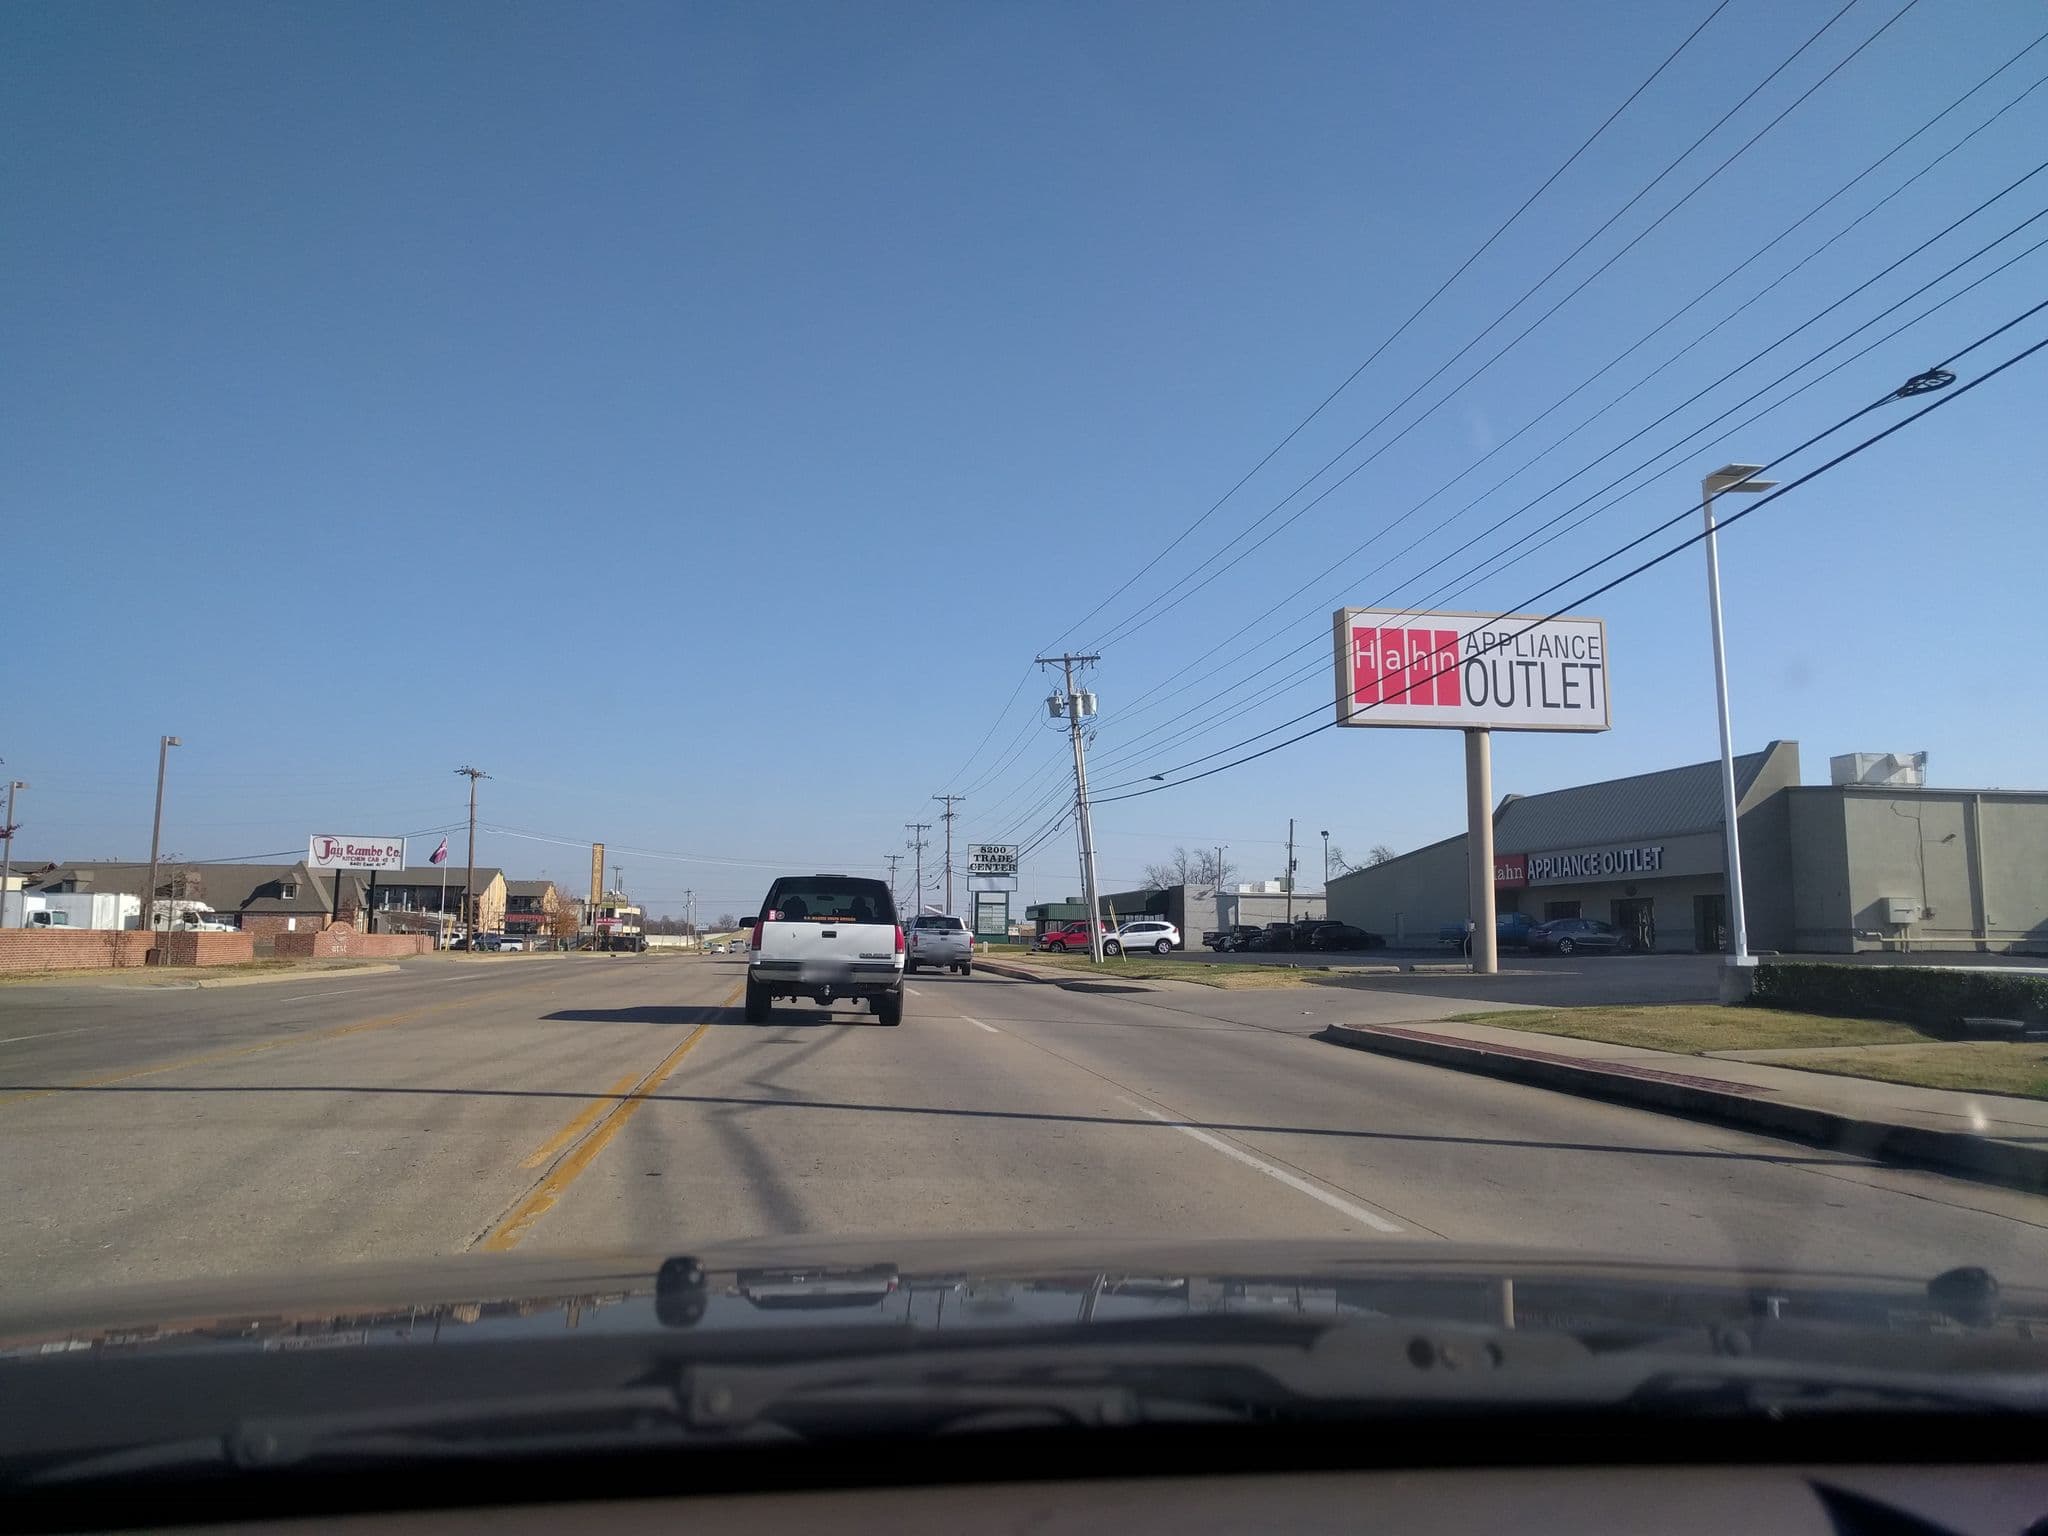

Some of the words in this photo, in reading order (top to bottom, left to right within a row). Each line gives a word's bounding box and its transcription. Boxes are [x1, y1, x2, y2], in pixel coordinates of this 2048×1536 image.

[1354, 639, 1456, 672] Hahn
[1464, 631, 1601, 661] APPLIANCE
[1464, 658, 1602, 710] OUTLET
[318, 840, 343, 860] Jay
[346, 845, 383, 857] Rambo
[386, 846, 401, 858] Co.
[973, 854, 1014, 863] TRADE
[980, 846, 1007, 854] 8200
[969, 863, 1017, 872] CENTER
[1493, 863, 1524, 881] ahn
[1528, 852, 1600, 880] APPLIANCE
[1602, 846, 1664, 874] OUTLET
